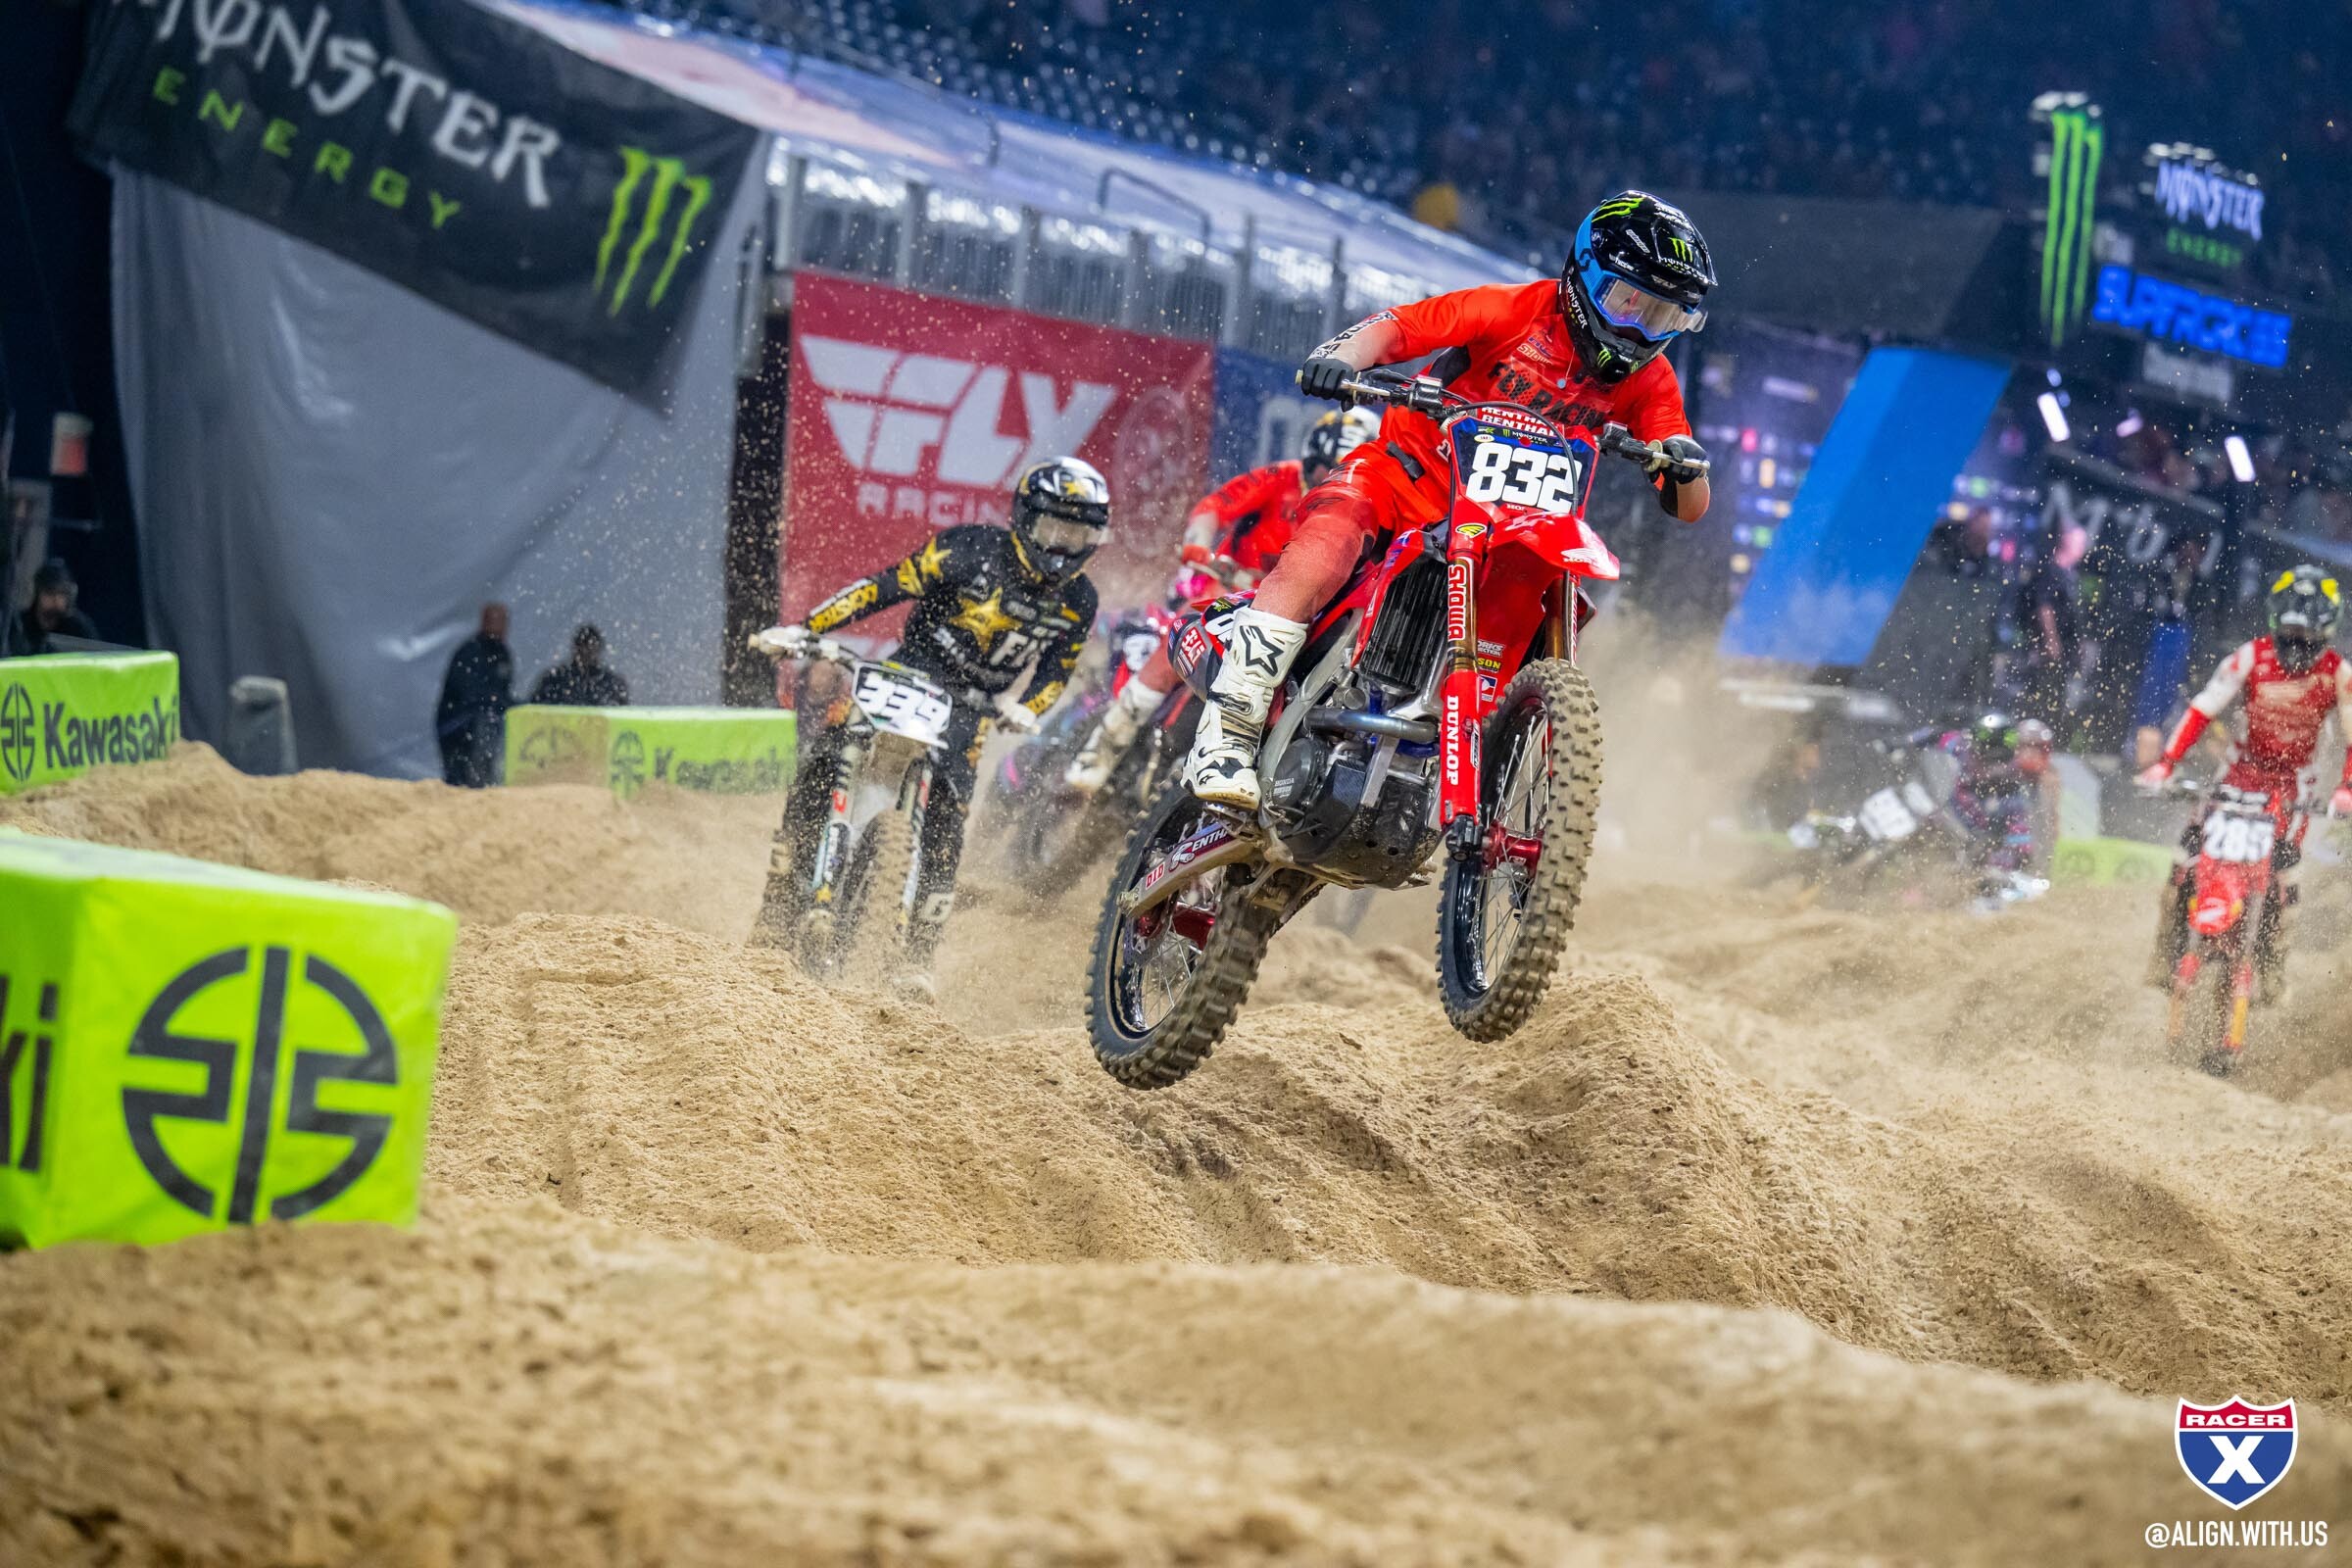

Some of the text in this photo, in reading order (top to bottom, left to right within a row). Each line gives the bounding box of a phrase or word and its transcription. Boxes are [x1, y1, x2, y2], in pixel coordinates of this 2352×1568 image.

[112, 0, 562, 209] ONSTER
[153, 66, 461, 229] ENERGY
[799, 335, 1118, 491] FLY
[857, 482, 1014, 528] RACIN
[1466, 442, 1583, 514] 832
[44, 694, 179, 770] Kawasaki
[1446, 695, 1459, 786] DUNLOP
